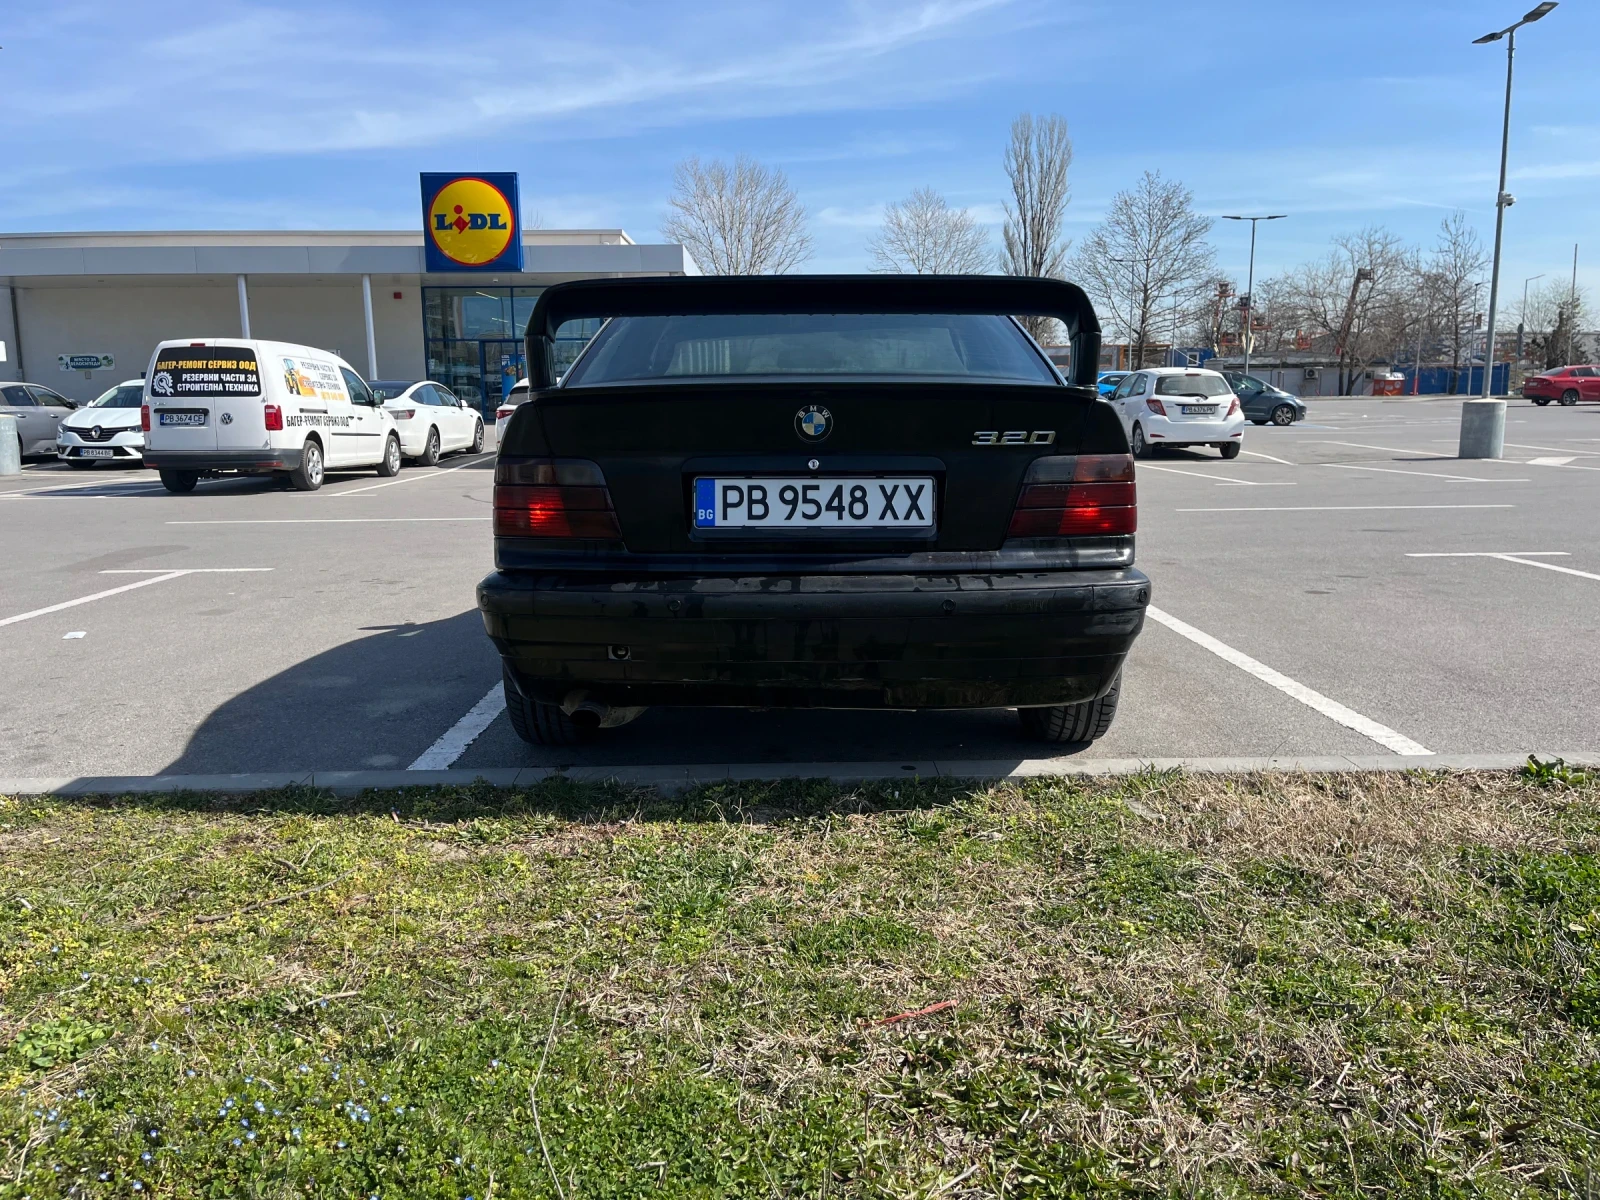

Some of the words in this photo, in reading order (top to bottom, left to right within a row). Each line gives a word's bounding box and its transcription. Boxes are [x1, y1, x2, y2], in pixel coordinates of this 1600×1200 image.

[157, 360, 207, 370] БАГЕР-РЕМОНТ
[208, 360, 237, 369] СЕРВИЗ
[238, 361, 256, 371] ООД
[182, 373, 219, 382] РЕЗЕРВНИ
[220, 374, 245, 382] ЧАСТИ
[246, 374, 258, 382] ЗА
[177, 383, 224, 392] СТРОИТЕЛНА
[224, 384, 258, 392] ТЕХНИКА
[798, 405, 830, 418] BMW
[164, 414, 174, 422] PB
[193, 414, 203, 422] CE
[972, 430, 1056, 445] 320
[698, 509, 714, 520] BG
[722, 484, 770, 521] PB
[778, 484, 868, 521] 9548
[878, 484, 926, 521] XX
